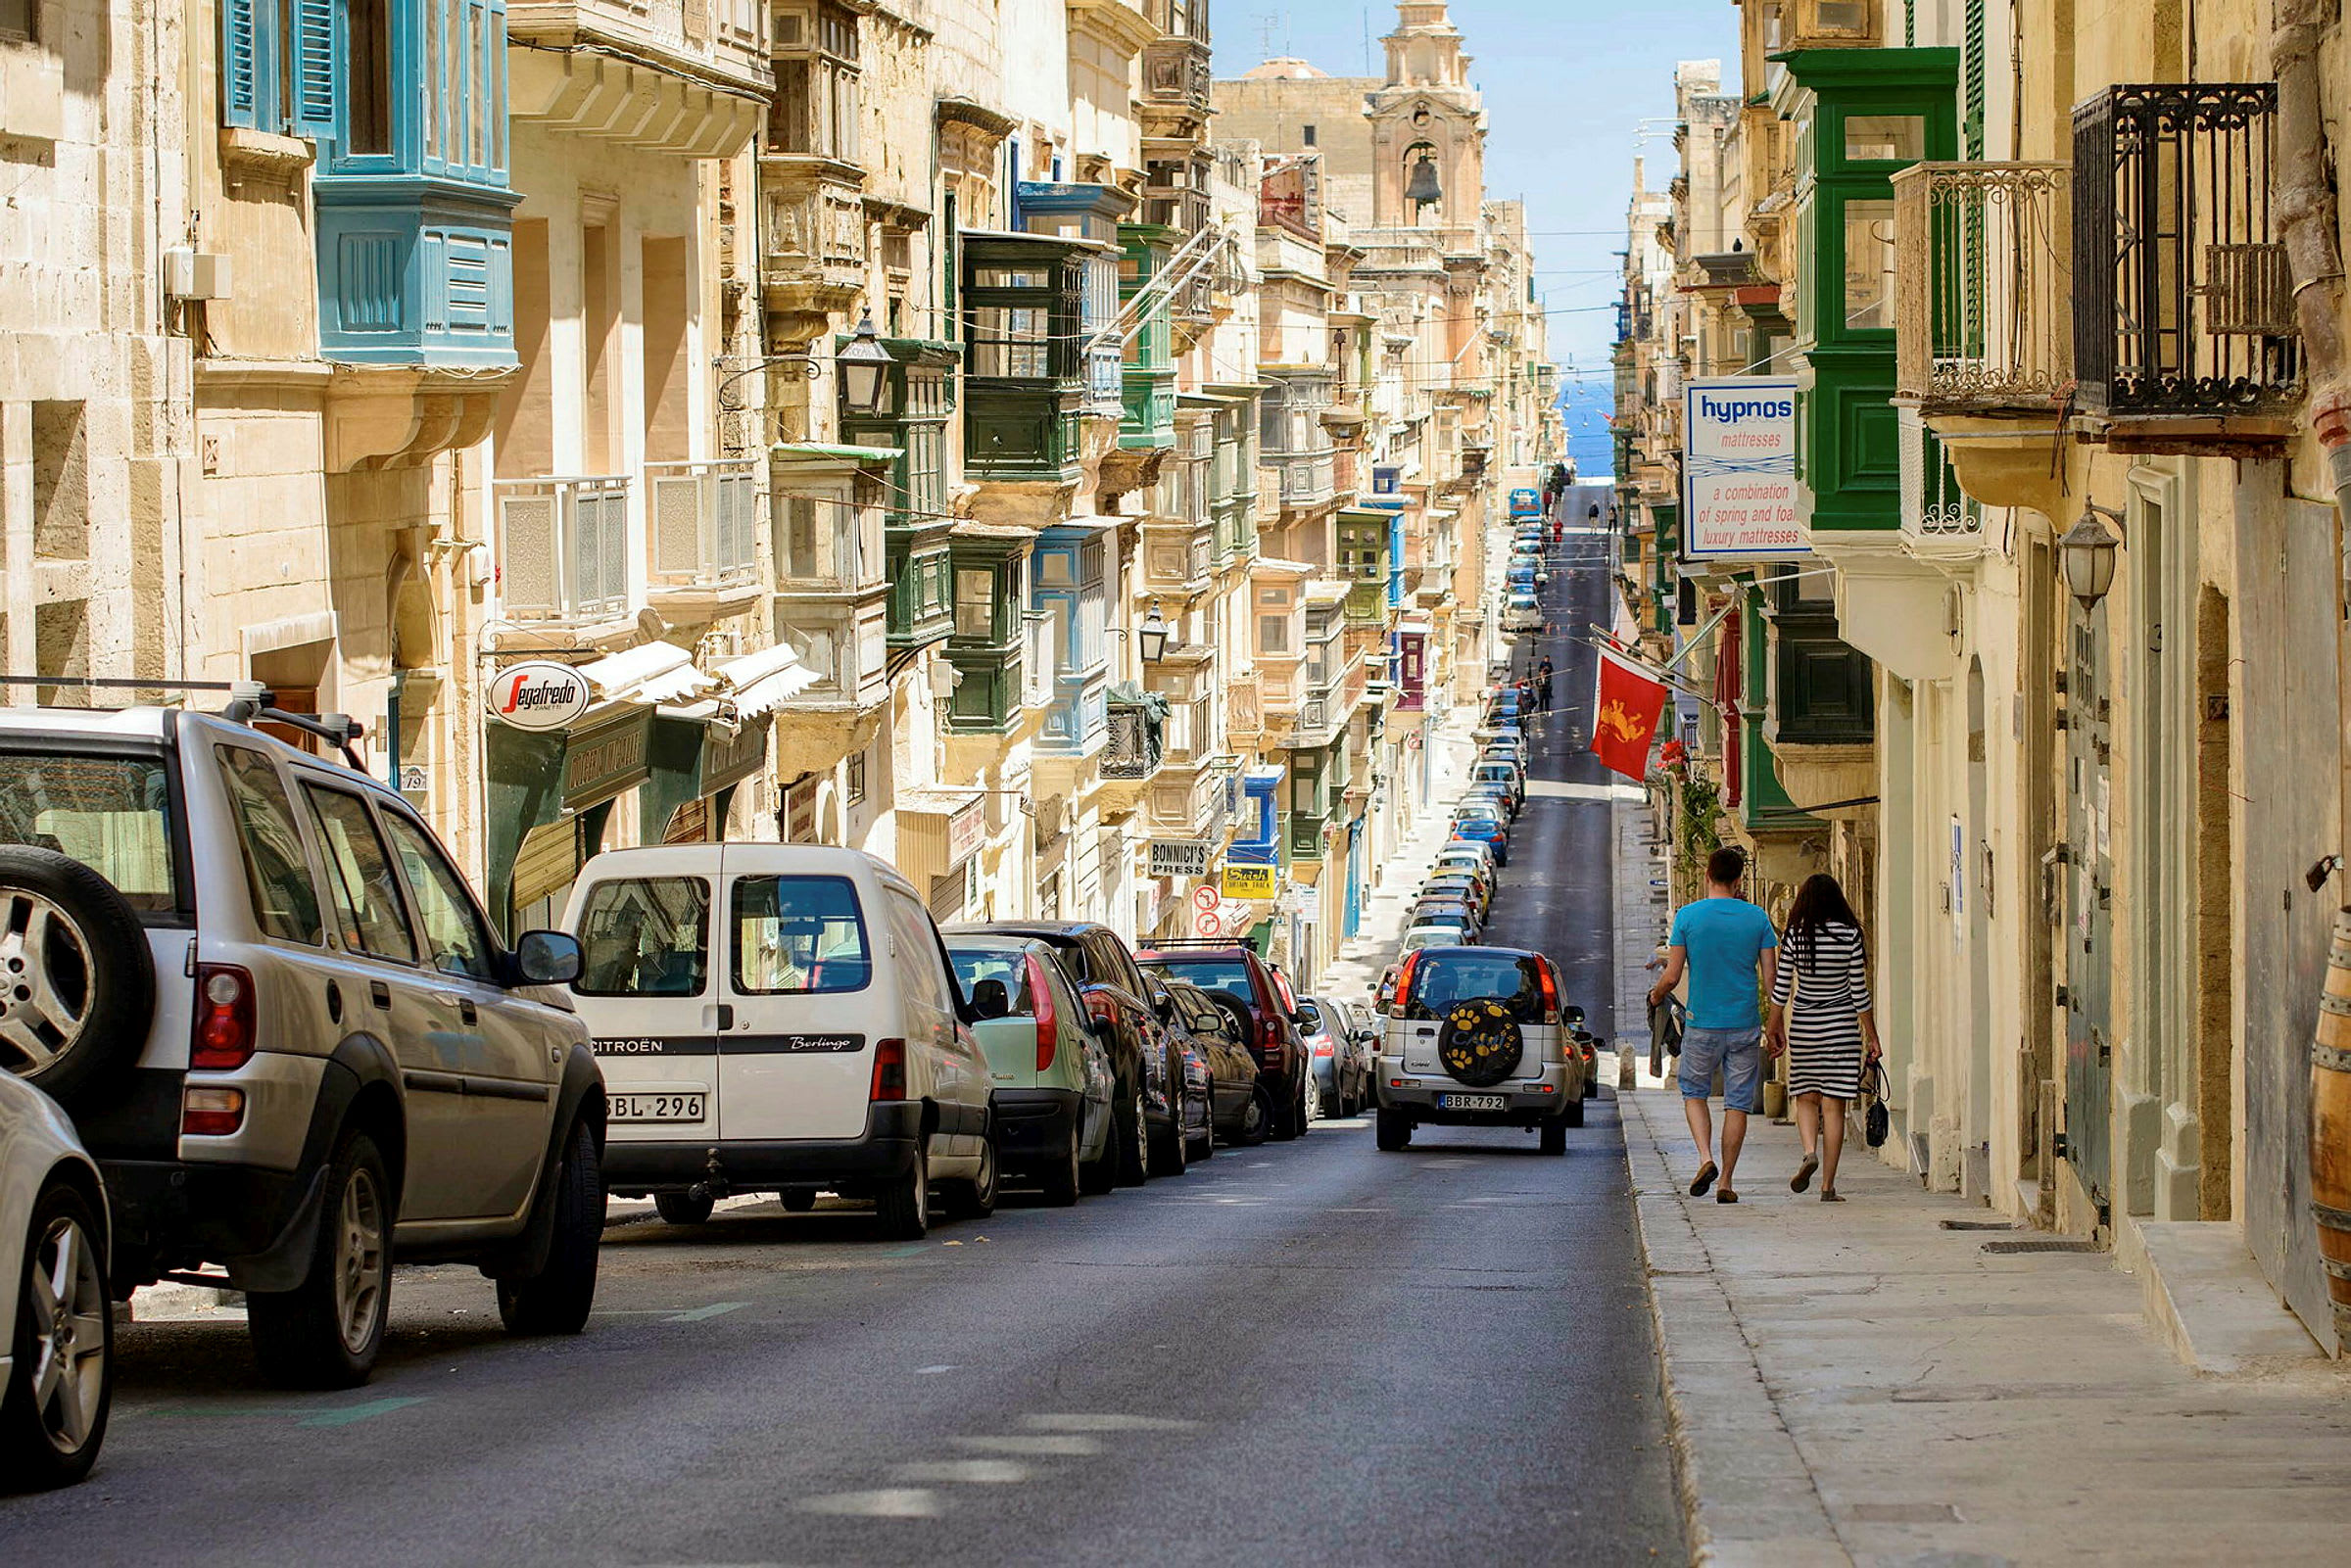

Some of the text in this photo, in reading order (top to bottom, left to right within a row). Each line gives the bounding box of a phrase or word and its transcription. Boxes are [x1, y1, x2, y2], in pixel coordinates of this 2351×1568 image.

[1702, 395, 1792, 423] hypnos
[1721, 431, 1781, 448] mattresses
[1713, 484, 1789, 500] a combination
[1699, 504, 1799, 526] of spring and foa
[1703, 530, 1799, 546] luxury mattresses
[502, 675, 576, 714] Segafredo
[407, 777, 421, 788] 19
[1152, 843, 1205, 864] BONNICI'S
[1152, 864, 1204, 875] PRESS
[591, 1038, 663, 1053] CITROËN
[790, 1036, 850, 1051] Berlingo
